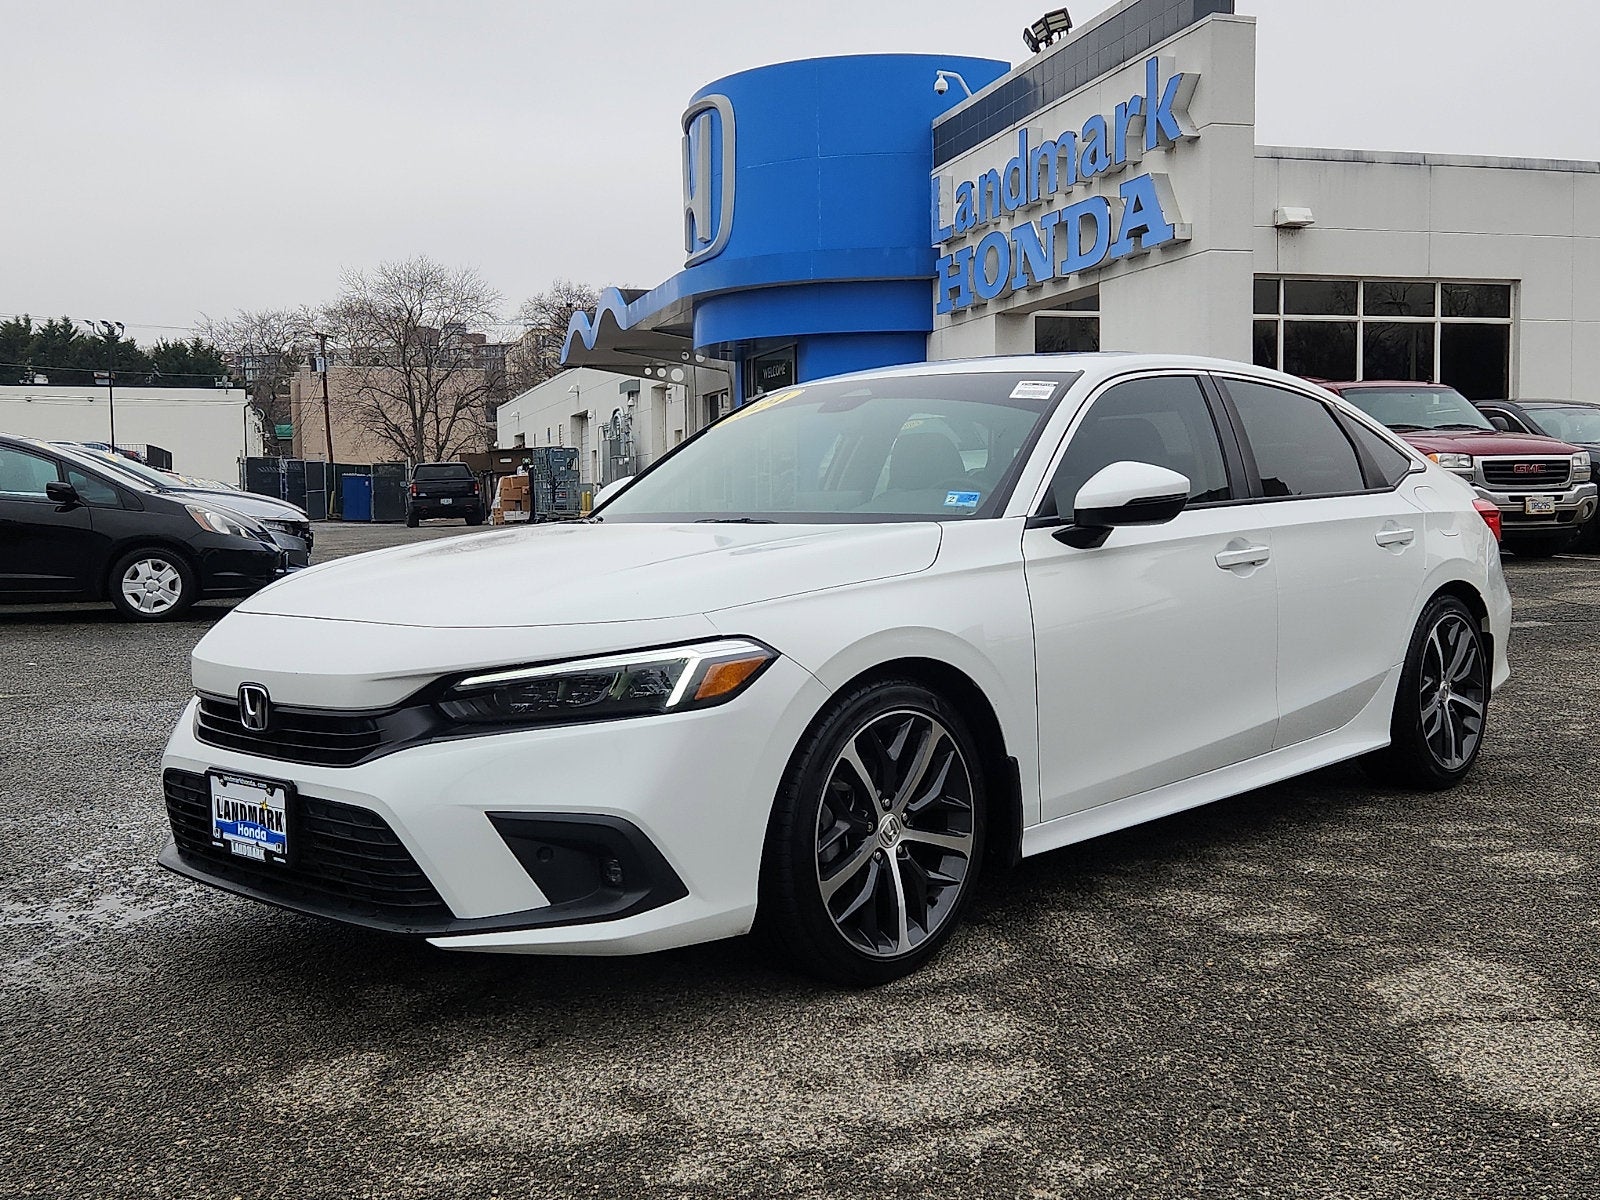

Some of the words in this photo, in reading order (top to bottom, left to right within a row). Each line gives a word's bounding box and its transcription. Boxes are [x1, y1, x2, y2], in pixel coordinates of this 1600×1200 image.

[931, 56, 1184, 247] Landmark
[936, 172, 1175, 315] HONDA
[762, 363, 786, 379] WELCOME
[1513, 463, 1547, 474] GMC
[216, 797, 284, 833] LANDMARK
[237, 823, 267, 841] Honda
